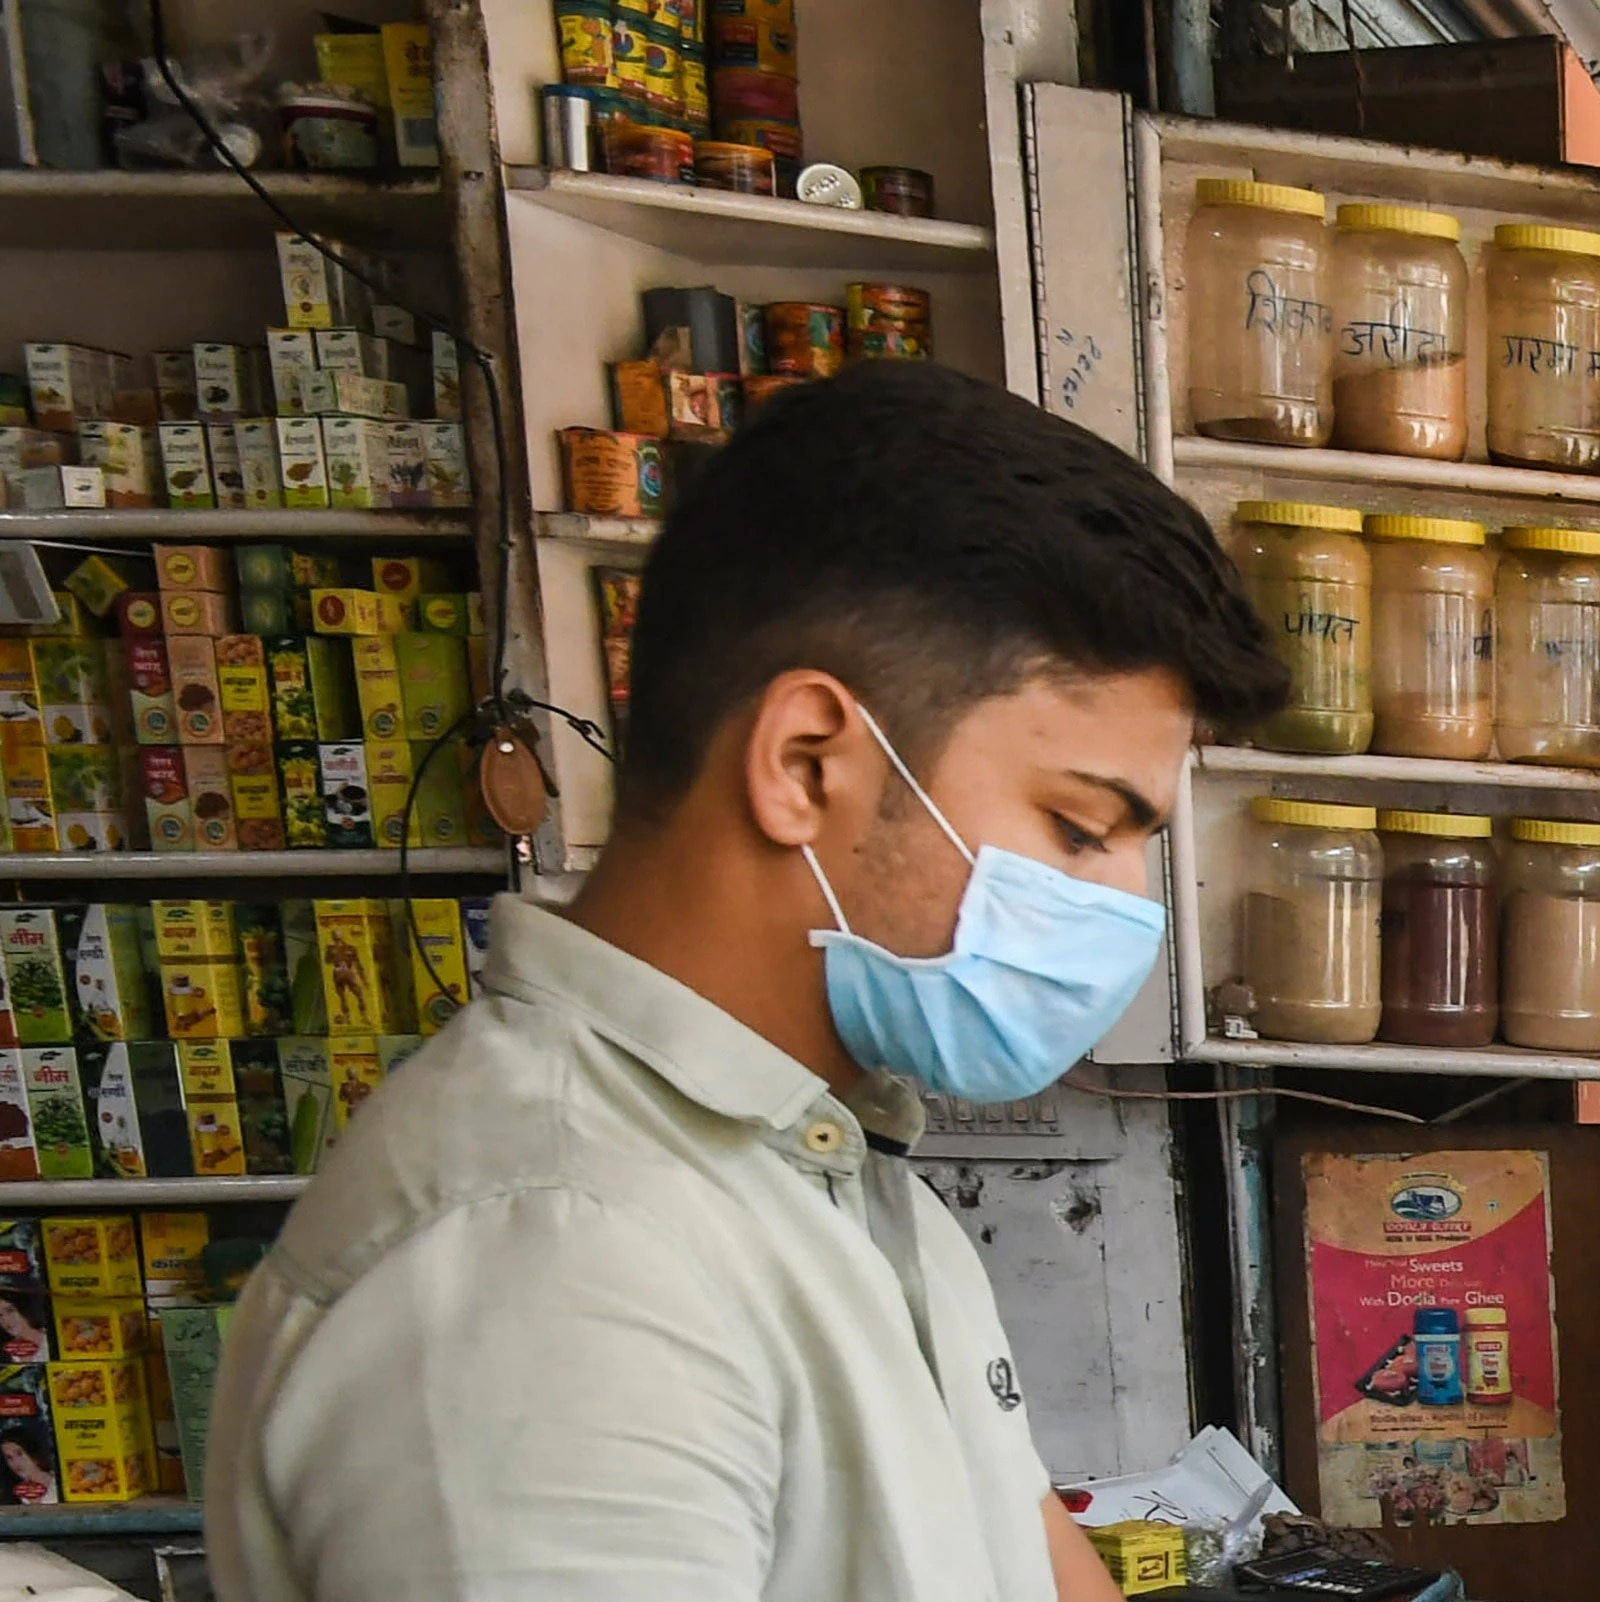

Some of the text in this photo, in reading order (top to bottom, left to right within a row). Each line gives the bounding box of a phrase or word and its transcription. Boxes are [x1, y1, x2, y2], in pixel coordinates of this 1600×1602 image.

[9, 928, 45, 946] नीम
[33, 1066, 70, 1084] नीम
[1409, 1258, 1464, 1273] Sweets
[1390, 1274, 1435, 1289] More
[1464, 1290, 1505, 1305] Ghee
